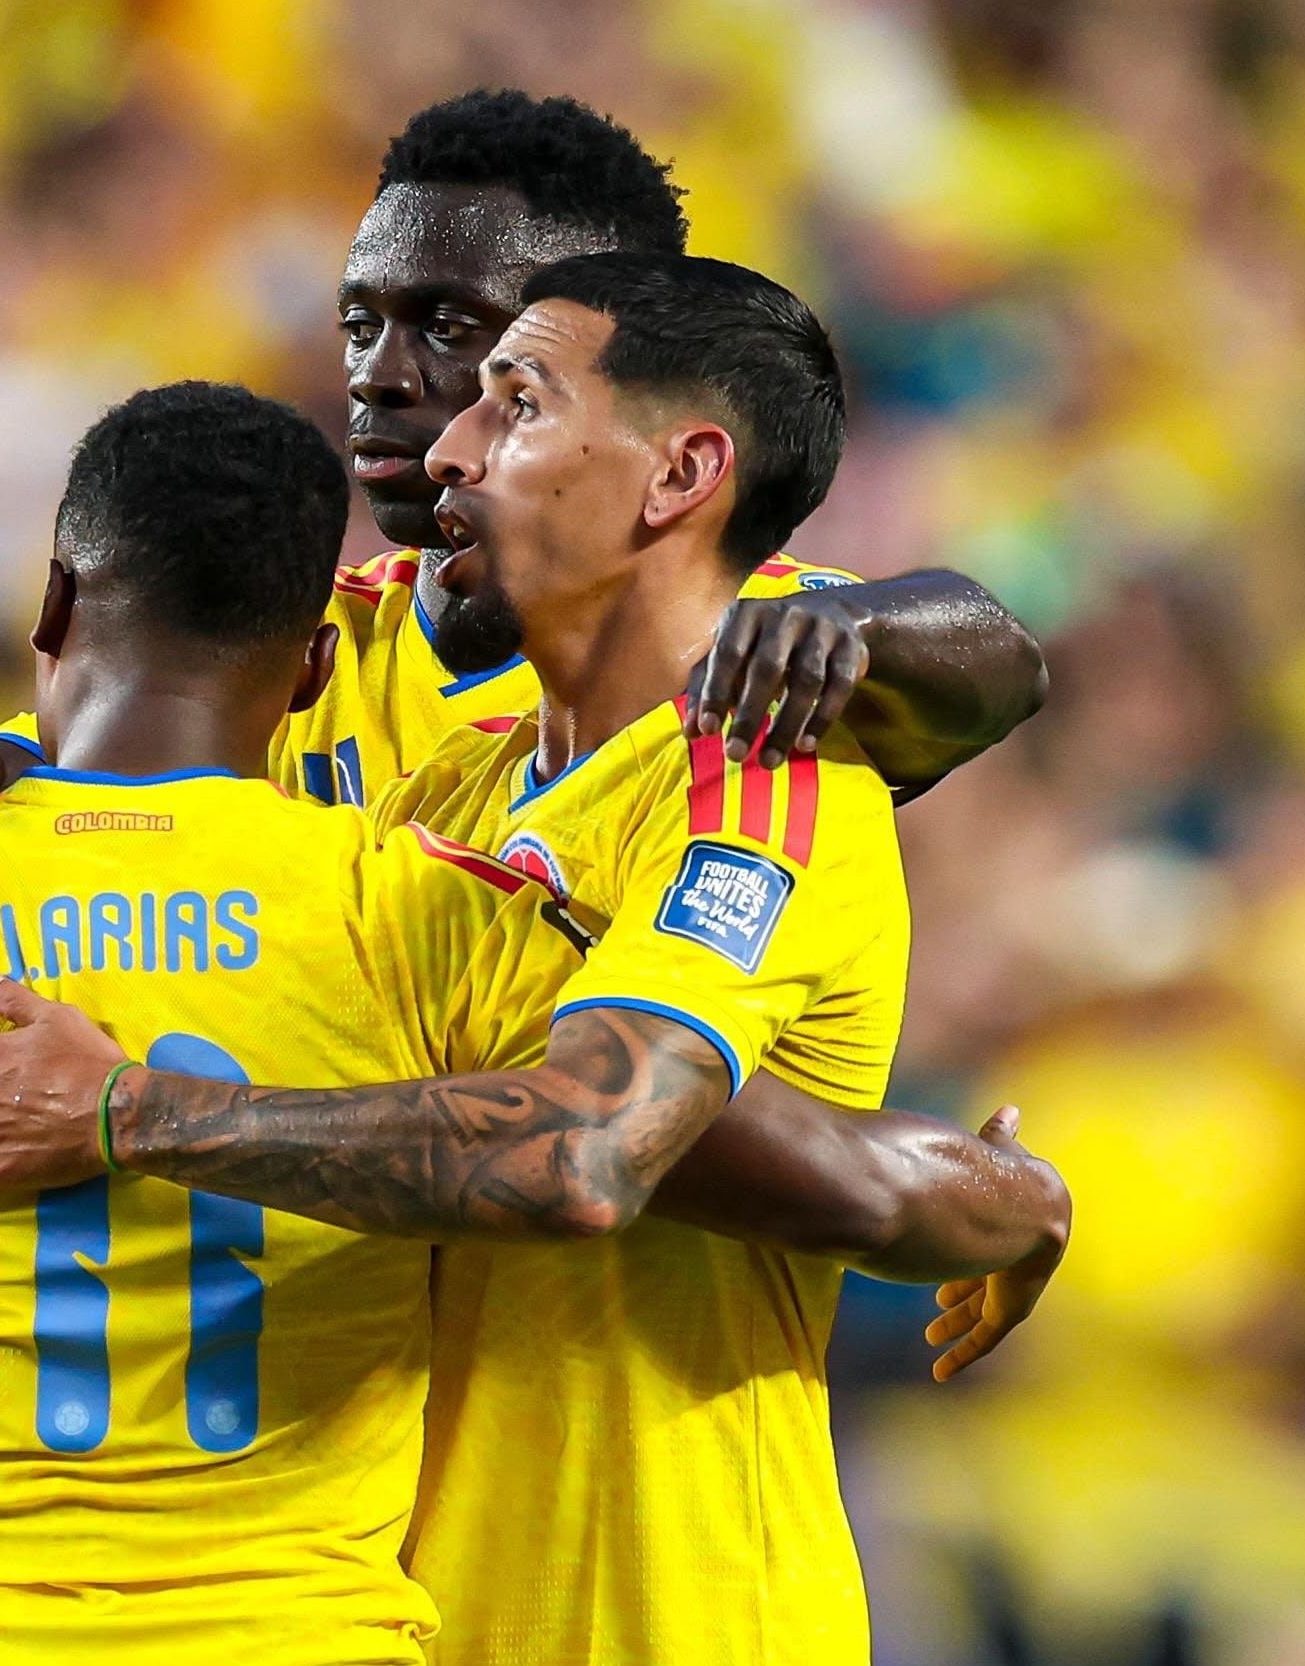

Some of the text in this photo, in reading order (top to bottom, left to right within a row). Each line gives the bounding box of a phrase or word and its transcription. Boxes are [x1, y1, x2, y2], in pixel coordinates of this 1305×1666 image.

[55, 812, 173, 835] COLOMBIA
[694, 875, 765, 919] UNITES
[700, 860, 769, 900] FOOTBALL
[0, 889, 260, 983] J.ARIAS
[681, 888, 760, 942] the World
